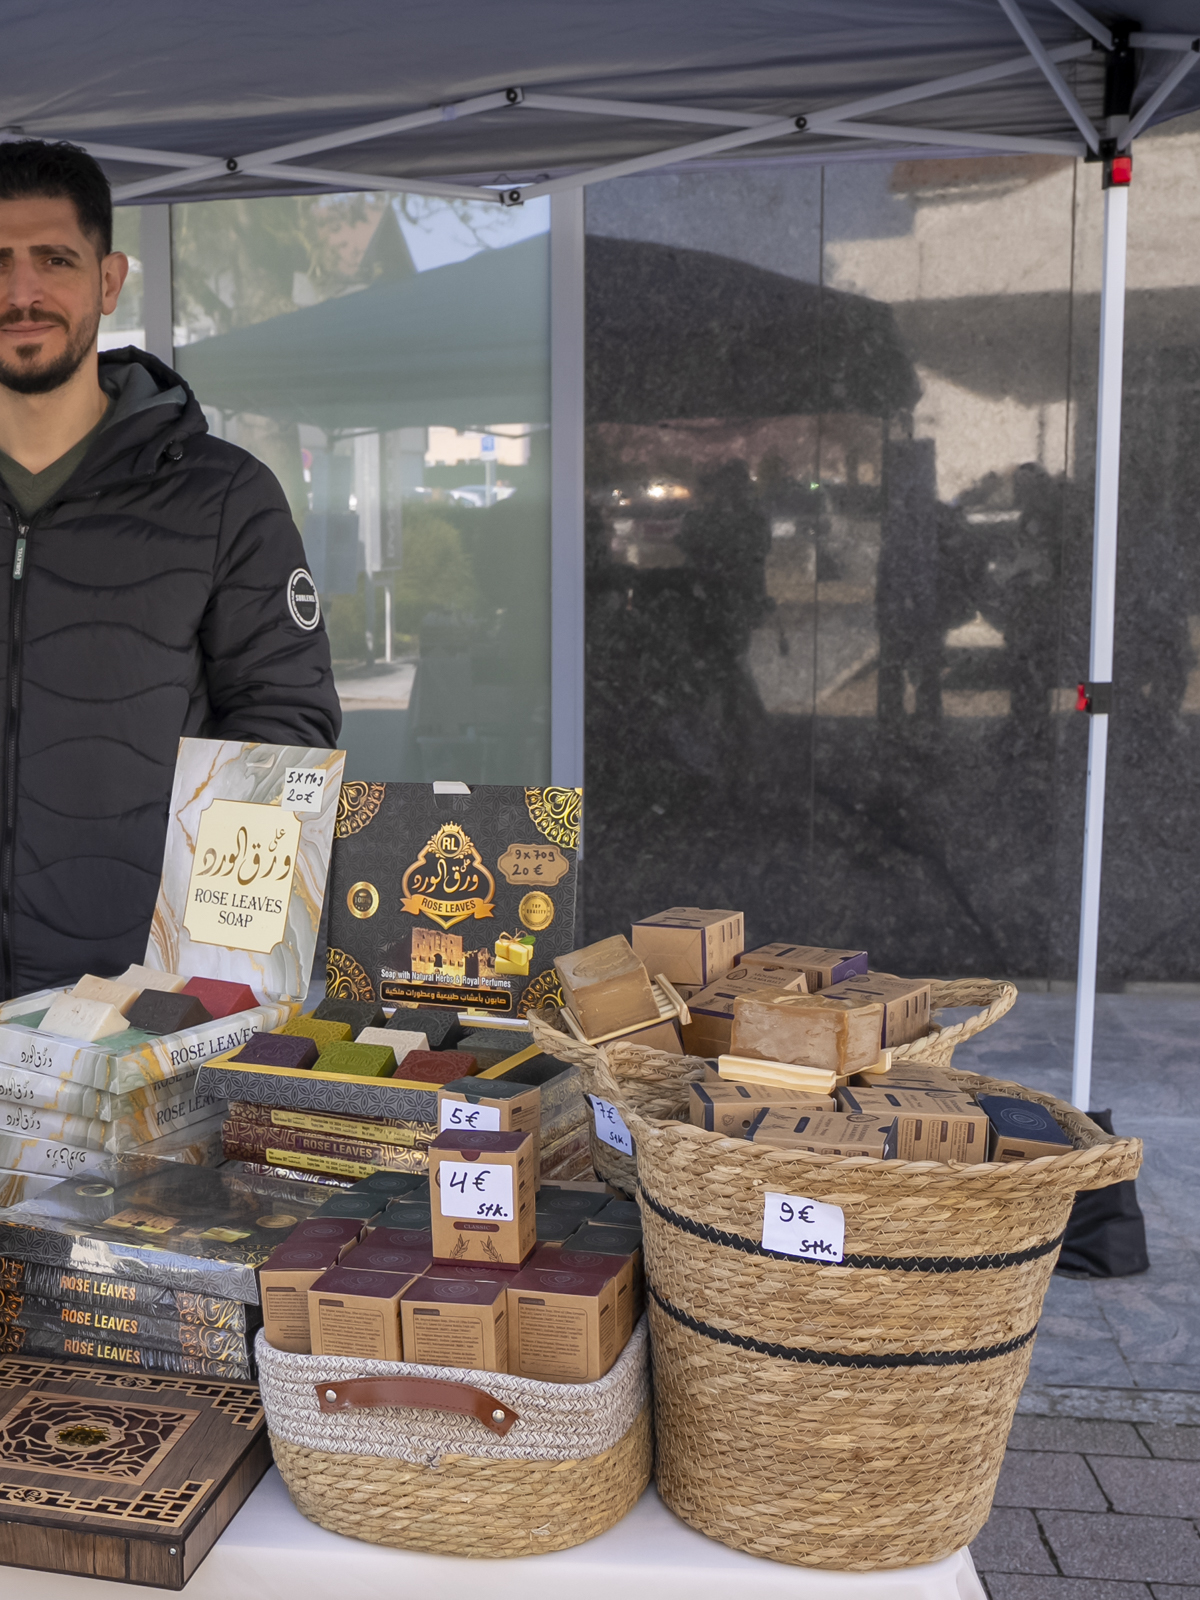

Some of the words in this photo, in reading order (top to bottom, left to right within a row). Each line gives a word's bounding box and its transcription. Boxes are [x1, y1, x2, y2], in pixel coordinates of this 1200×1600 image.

[442, 837, 458, 850] RL
[194, 887, 229, 906] ROSE
[231, 893, 283, 914] LEAVES
[421, 897, 443, 912] ROSE
[445, 899, 476, 913] LEAVES
[218, 910, 253, 928] SOAP
[380, 969, 396, 980] Soap
[398, 970, 411, 980] with
[412, 972, 434, 982] Natural
[435, 974, 453, 984] Herbs
[462, 976, 480, 987] Royal
[481, 977, 511, 988] Perfumes
[171, 1042, 207, 1067] ROSE
[209, 1025, 259, 1055] LEAVES
[156, 1101, 186, 1126] ROSE
[303, 1139, 331, 1151] ROSE
[334, 1143, 373, 1158] LEAVES
[463, 1223, 491, 1231] CLASSIC
[60, 1275, 90, 1292] ROSE
[93, 1281, 136, 1301] LEAVES
[61, 1308, 91, 1326] ROSE
[94, 1314, 138, 1334] LEAVES
[64, 1339, 94, 1356] ROSE
[97, 1344, 141, 1364] LEAVES
